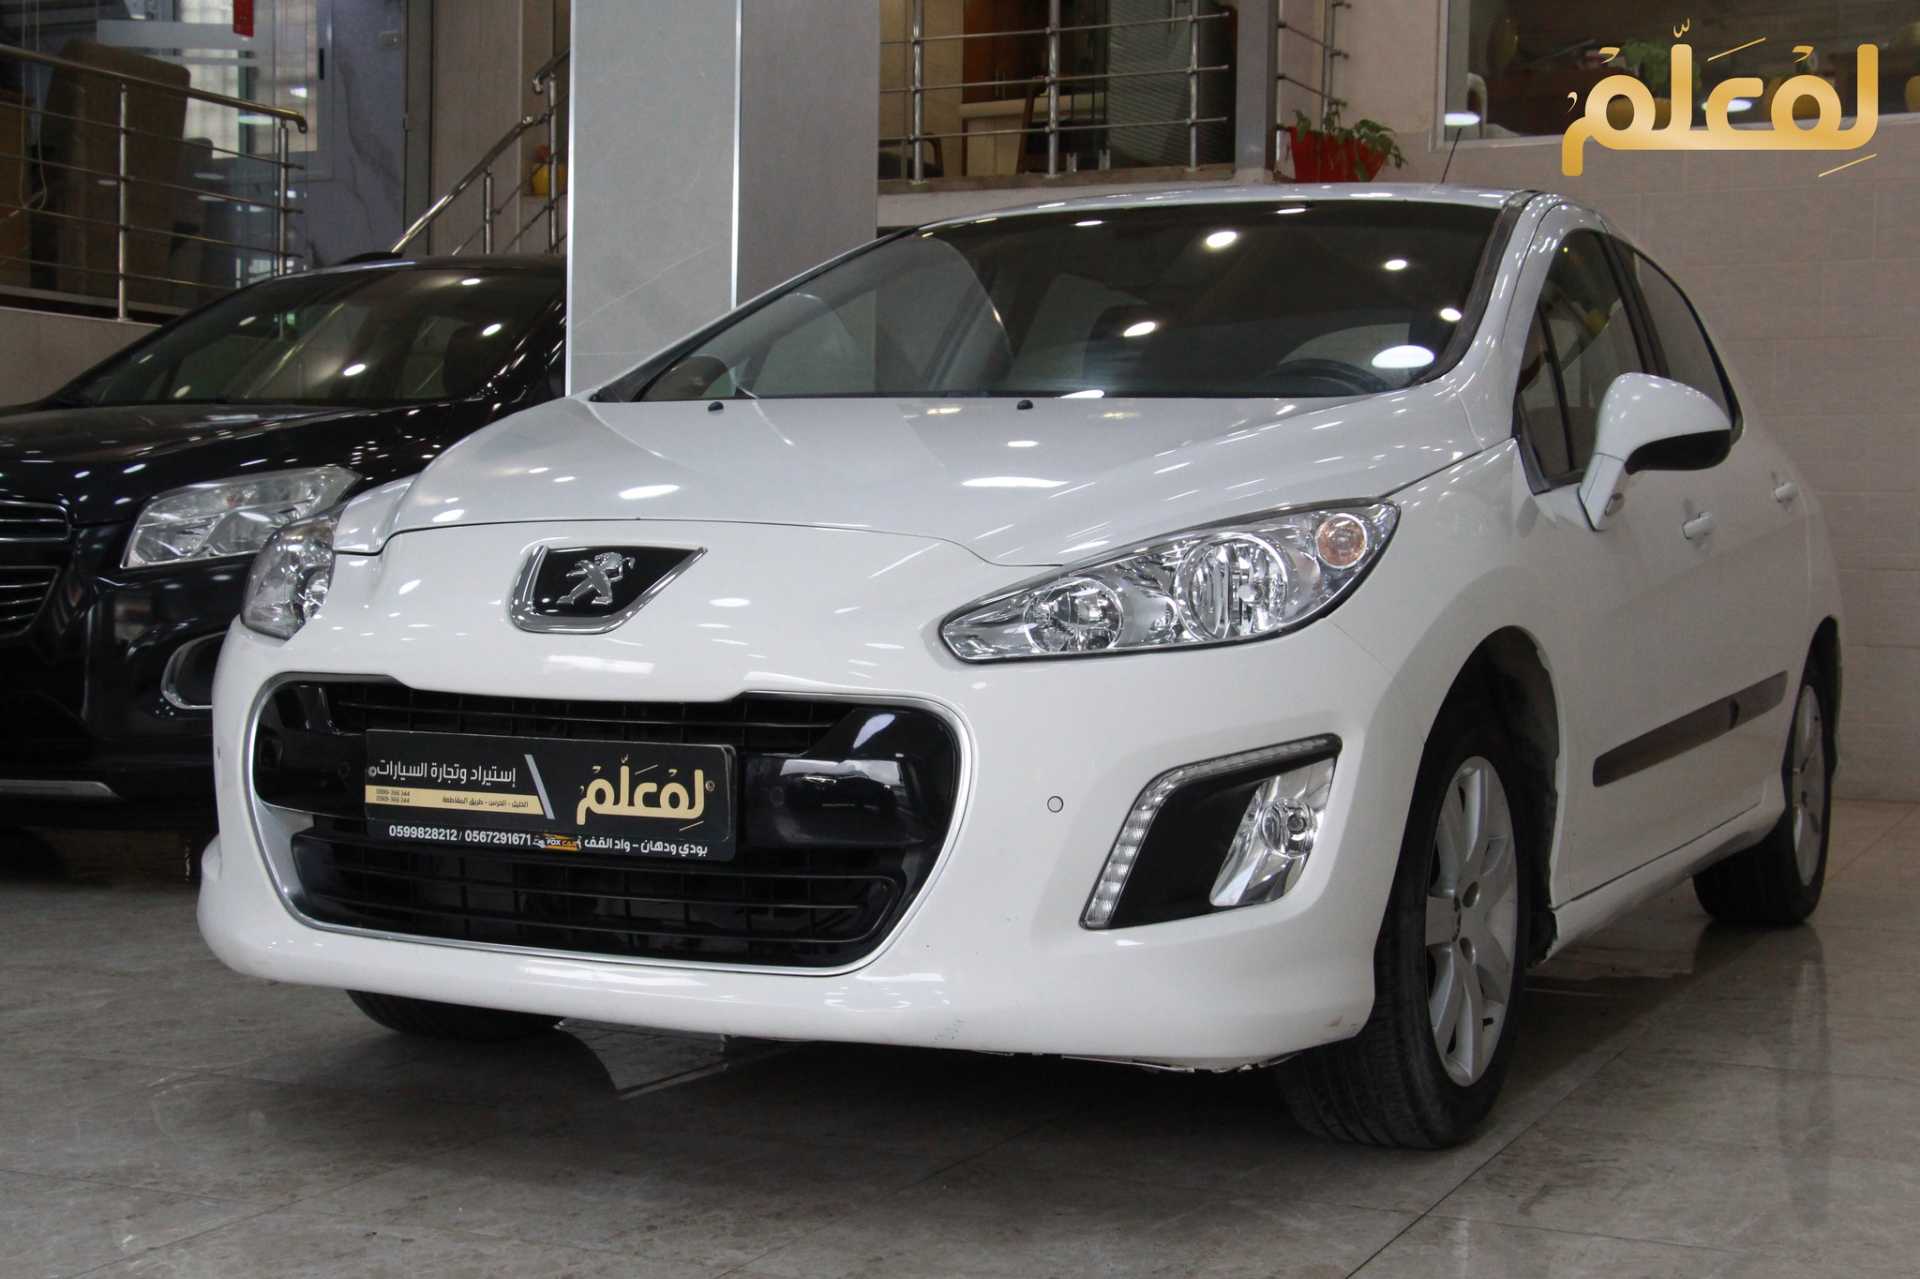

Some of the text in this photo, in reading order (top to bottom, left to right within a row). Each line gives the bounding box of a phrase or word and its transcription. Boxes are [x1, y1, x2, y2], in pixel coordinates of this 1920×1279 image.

[376, 759, 516, 788] إستيراد وتجارة السيارات
[388, 825, 458, 841] 0599828212
[465, 829, 531, 846] 0567291671
[614, 838, 631, 853] واد
[640, 839, 677, 856] ودهان
[678, 843, 708, 857] بودي
